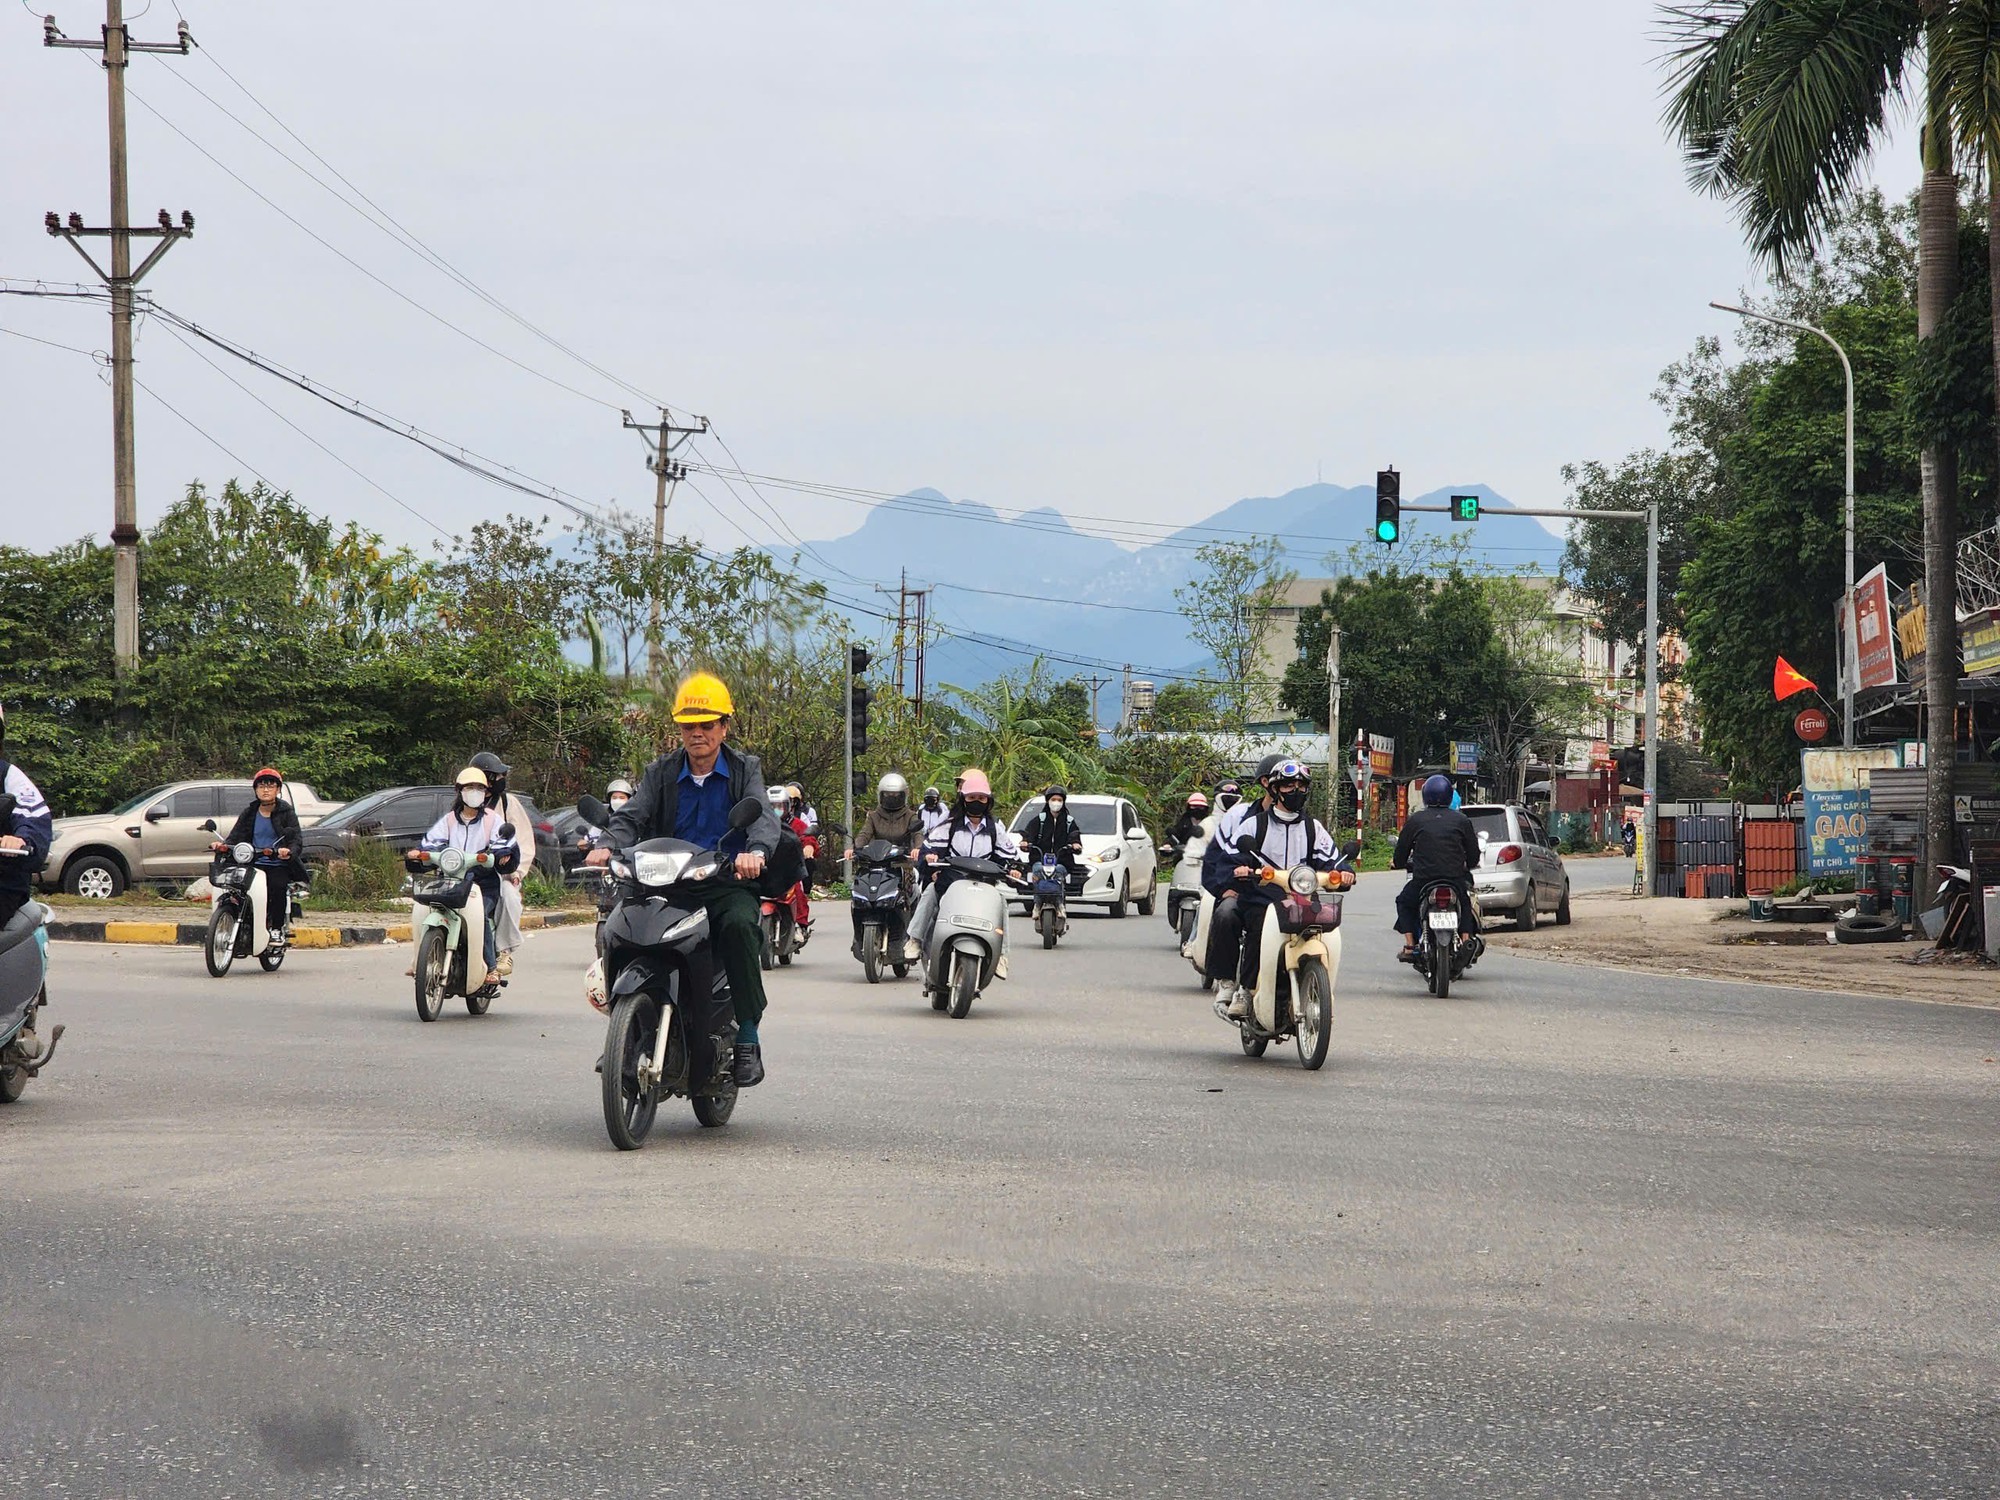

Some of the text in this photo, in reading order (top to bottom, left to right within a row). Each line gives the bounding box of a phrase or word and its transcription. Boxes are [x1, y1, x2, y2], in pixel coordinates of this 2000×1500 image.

[1461, 499, 1477, 518] 18
[1800, 718, 1825, 731] Ferroli
[1815, 813, 1867, 845] GẠO
